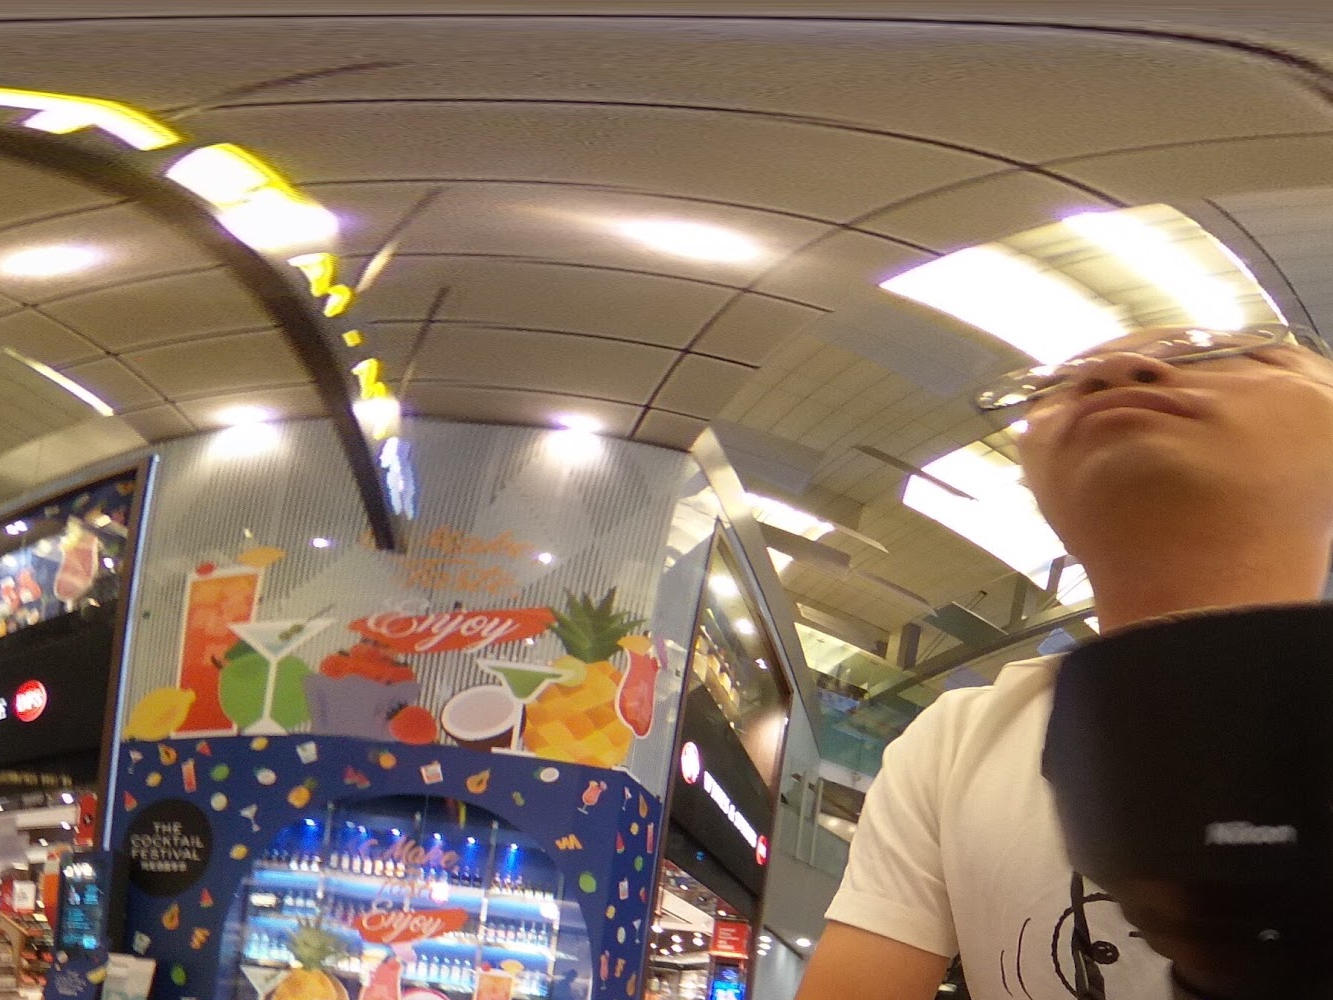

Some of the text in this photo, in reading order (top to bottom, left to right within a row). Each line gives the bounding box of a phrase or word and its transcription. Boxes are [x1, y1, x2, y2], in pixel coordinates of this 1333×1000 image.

[367, 597, 521, 654] Enjoy
[152, 820, 183, 835] THE
[129, 833, 206, 849] COCKTAIL
[130, 846, 202, 862] FESTIVAL
[361, 897, 446, 944] Enjoy
